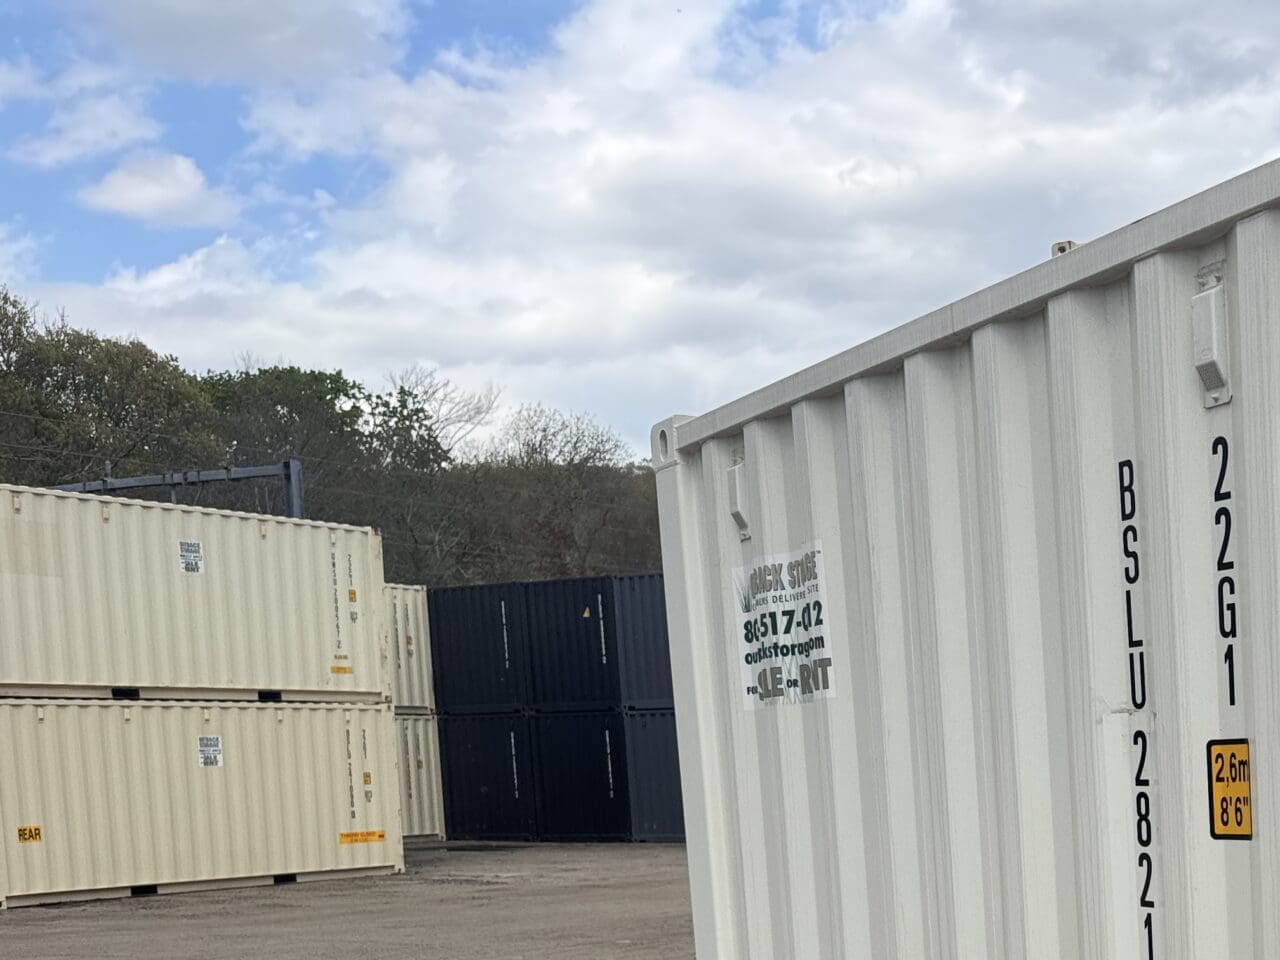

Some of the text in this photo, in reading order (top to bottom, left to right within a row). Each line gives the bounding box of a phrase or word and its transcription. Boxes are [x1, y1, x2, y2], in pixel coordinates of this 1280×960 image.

[1118, 459, 1146, 710] BSLU
[1211, 435, 1237, 706] 22G1
[786, 679, 799, 688] OR
[18, 828, 41, 841] REAR
